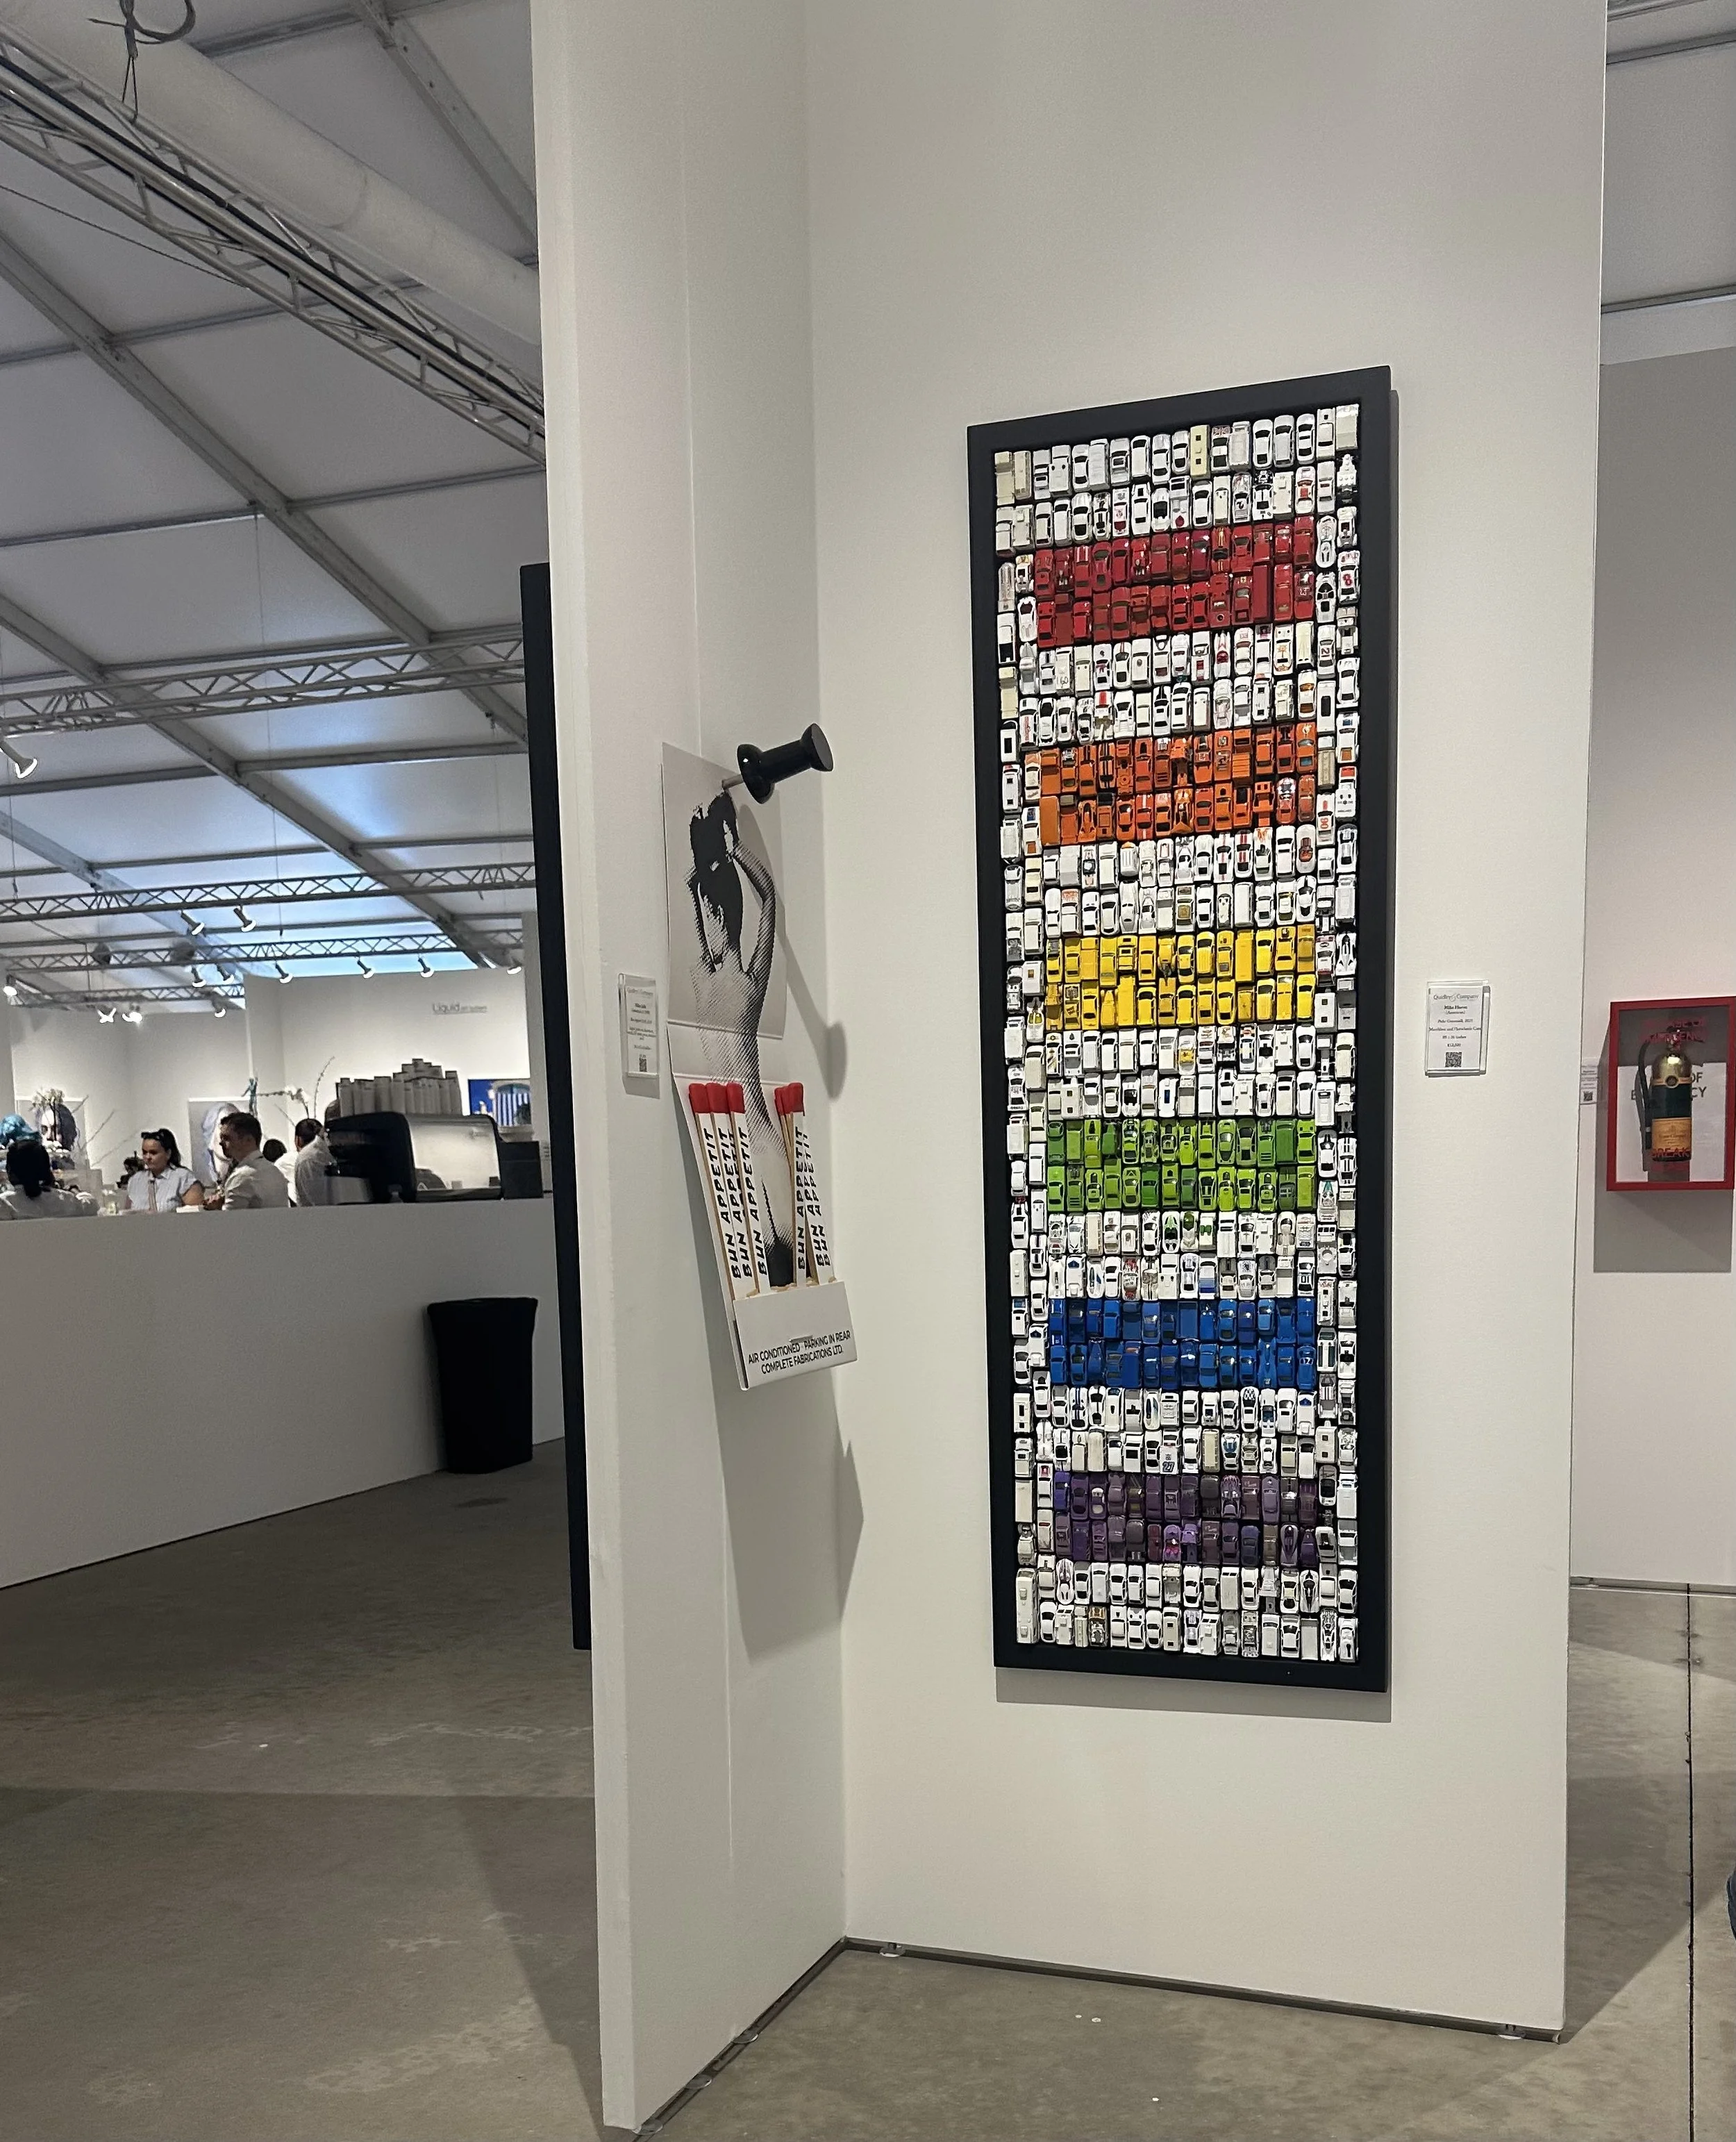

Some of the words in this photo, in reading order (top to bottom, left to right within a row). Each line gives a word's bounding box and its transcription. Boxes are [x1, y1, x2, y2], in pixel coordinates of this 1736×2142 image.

[703, 1128, 731, 1224] APPETIT
[718, 1127, 742, 1223] APPETIT
[738, 1127, 759, 1222] APPETIT
[795, 1126, 804, 1218] APPETIT
[725, 1234, 742, 1279] BUN
[737, 1231, 753, 1278] BUN
[753, 1229, 767, 1275] BUN
[797, 1226, 806, 1270] BUN
[810, 1224, 824, 1266] BUN
[748, 1352, 760, 1364] AIR
[760, 1343, 801, 1361] CONDITIONED
[804, 1335, 829, 1350] PARKING
[828, 1334, 835, 1345] IN
[835, 1330, 851, 1342] REAR
[761, 1358, 794, 1375] COMPLETE
[794, 1350, 833, 1368] FABRICATIONS
